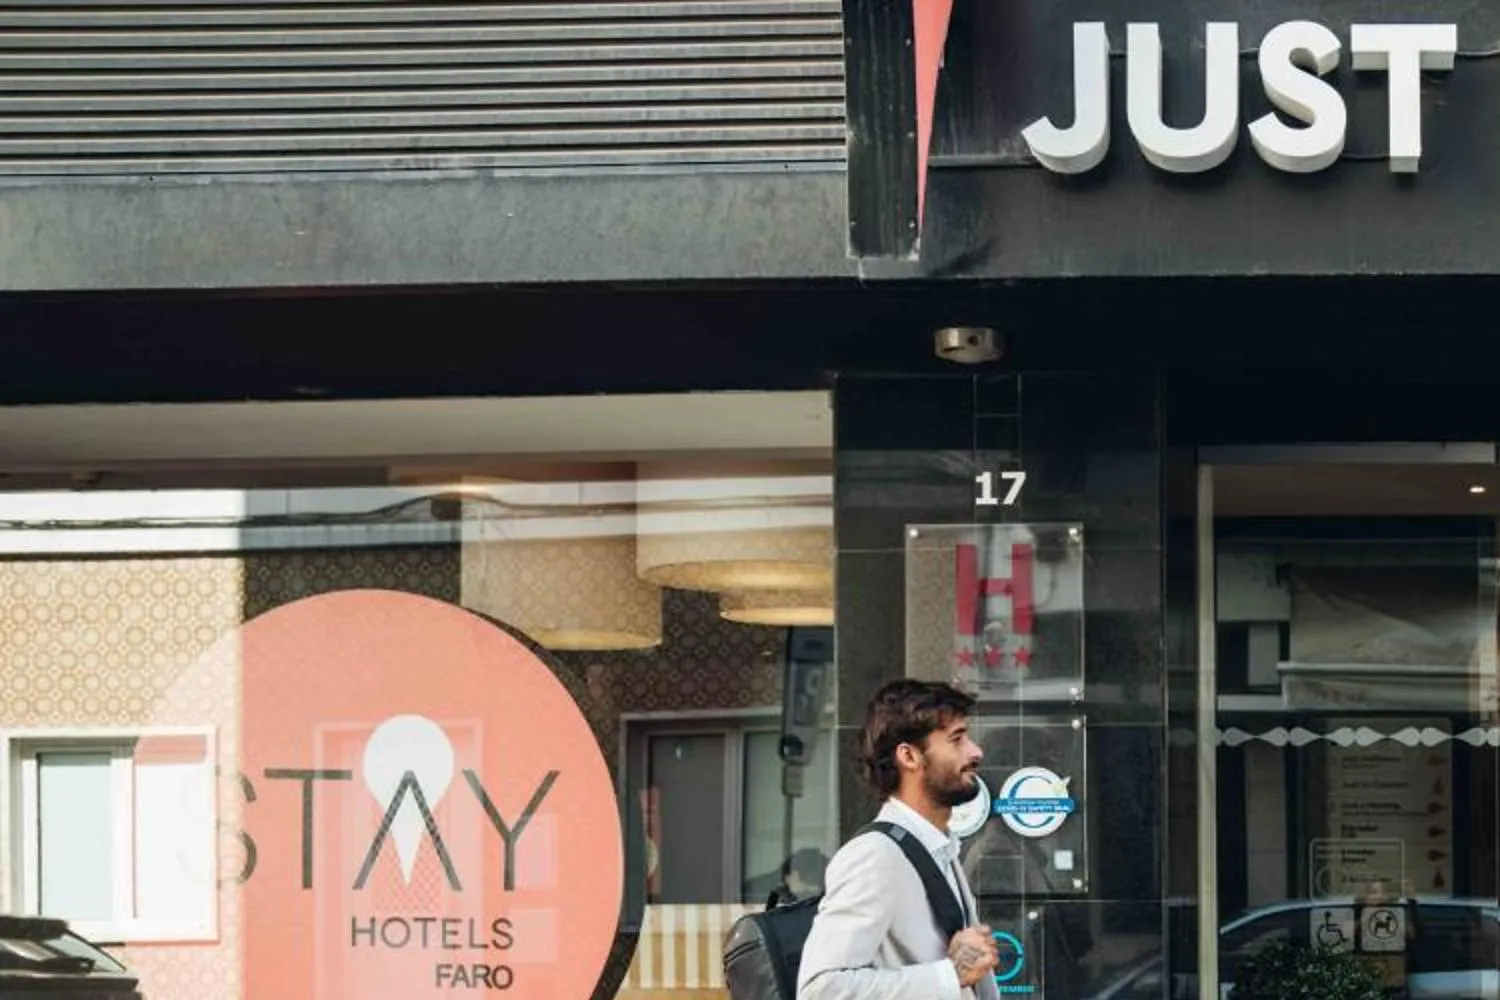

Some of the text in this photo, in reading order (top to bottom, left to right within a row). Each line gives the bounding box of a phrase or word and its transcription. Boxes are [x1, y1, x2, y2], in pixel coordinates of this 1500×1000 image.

[1021, 19, 1458, 174] JUST
[975, 471, 1027, 505] 17
[956, 543, 1036, 635] H
[351, 916, 514, 950] HOTELS
[435, 964, 513, 989] FARO
